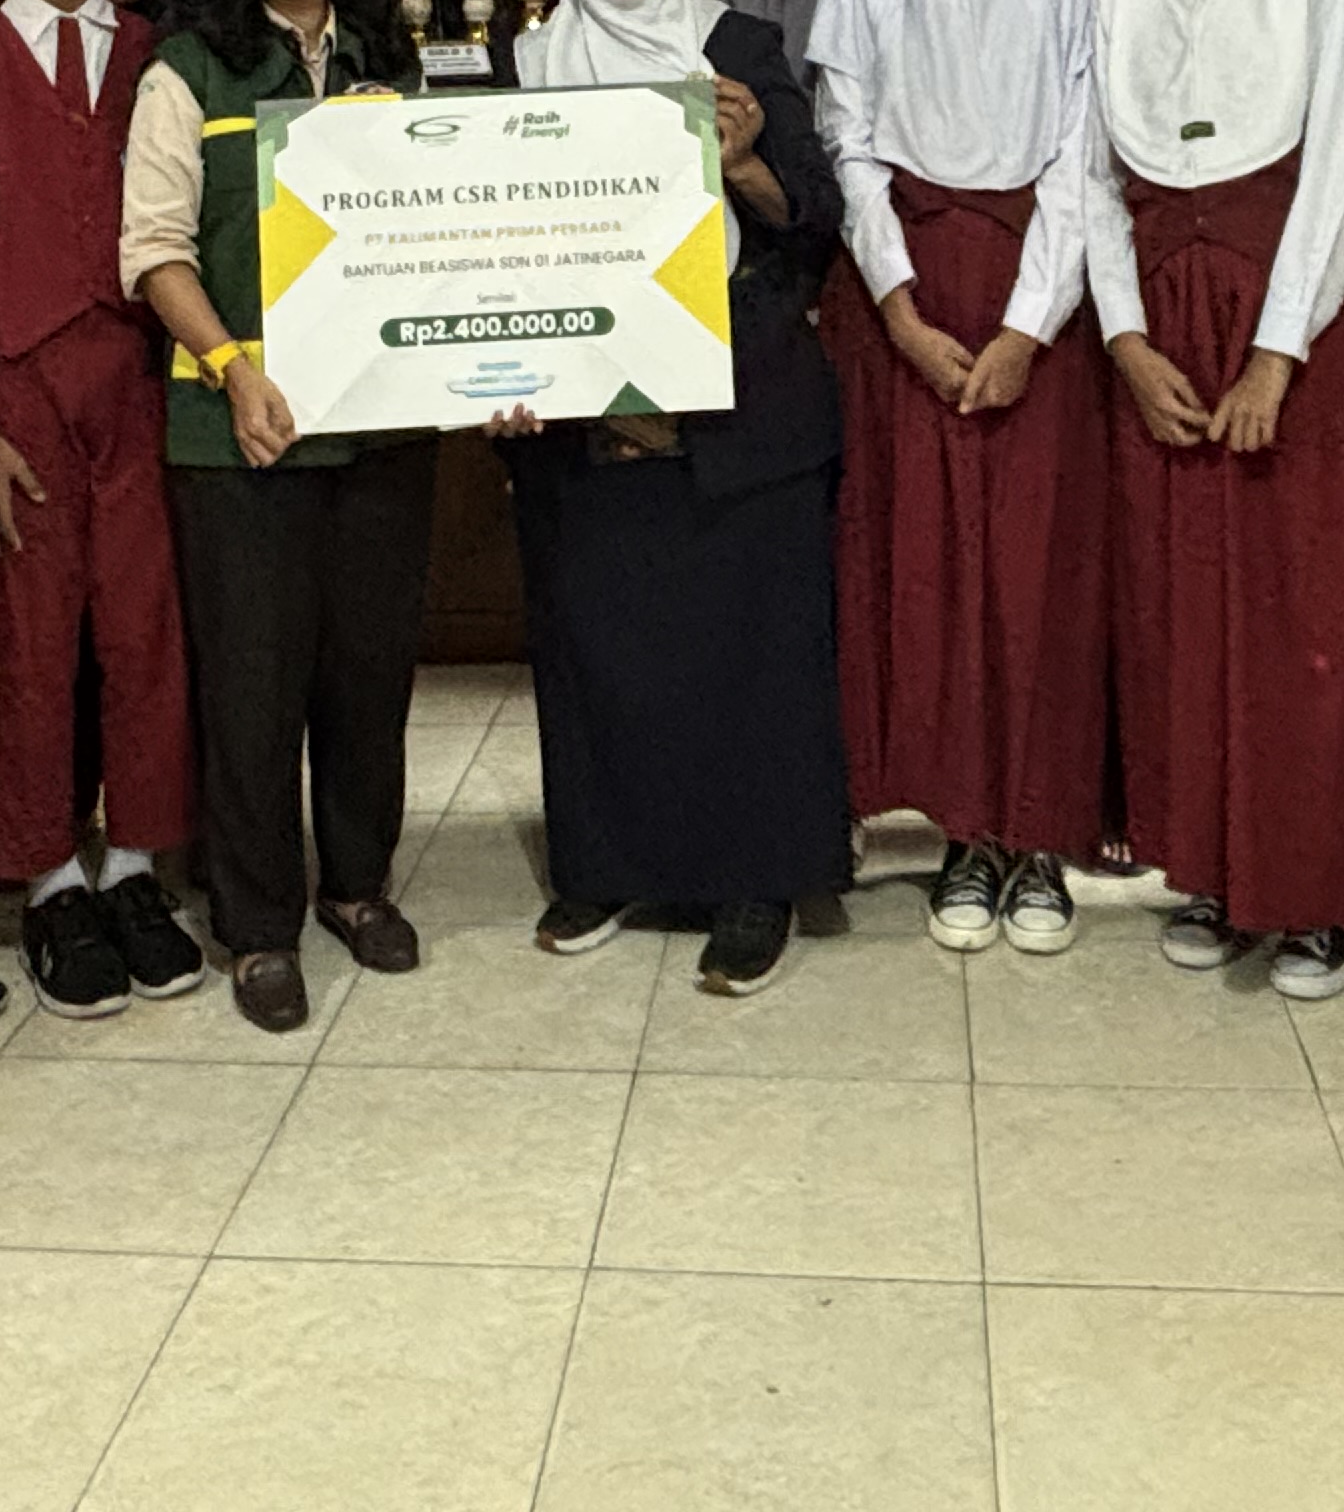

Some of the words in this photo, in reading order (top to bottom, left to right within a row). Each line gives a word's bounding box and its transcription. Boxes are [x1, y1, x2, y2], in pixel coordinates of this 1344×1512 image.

[522, 111, 561, 125] Raih
[322, 188, 444, 211] PROGRAM
[453, 184, 498, 205] CSR
[506, 176, 661, 201] PENDIDIKAN
[387, 227, 492, 246] KALIMANTAN
[496, 225, 546, 239] PRIMA
[550, 221, 623, 236] PERSADA
[343, 262, 415, 279] BANTUAN
[419, 258, 495, 275] BEASISWA
[499, 255, 531, 270] SDN
[553, 248, 646, 266] JATINEGARA
[399, 310, 596, 347] Rp2.400.000,00
